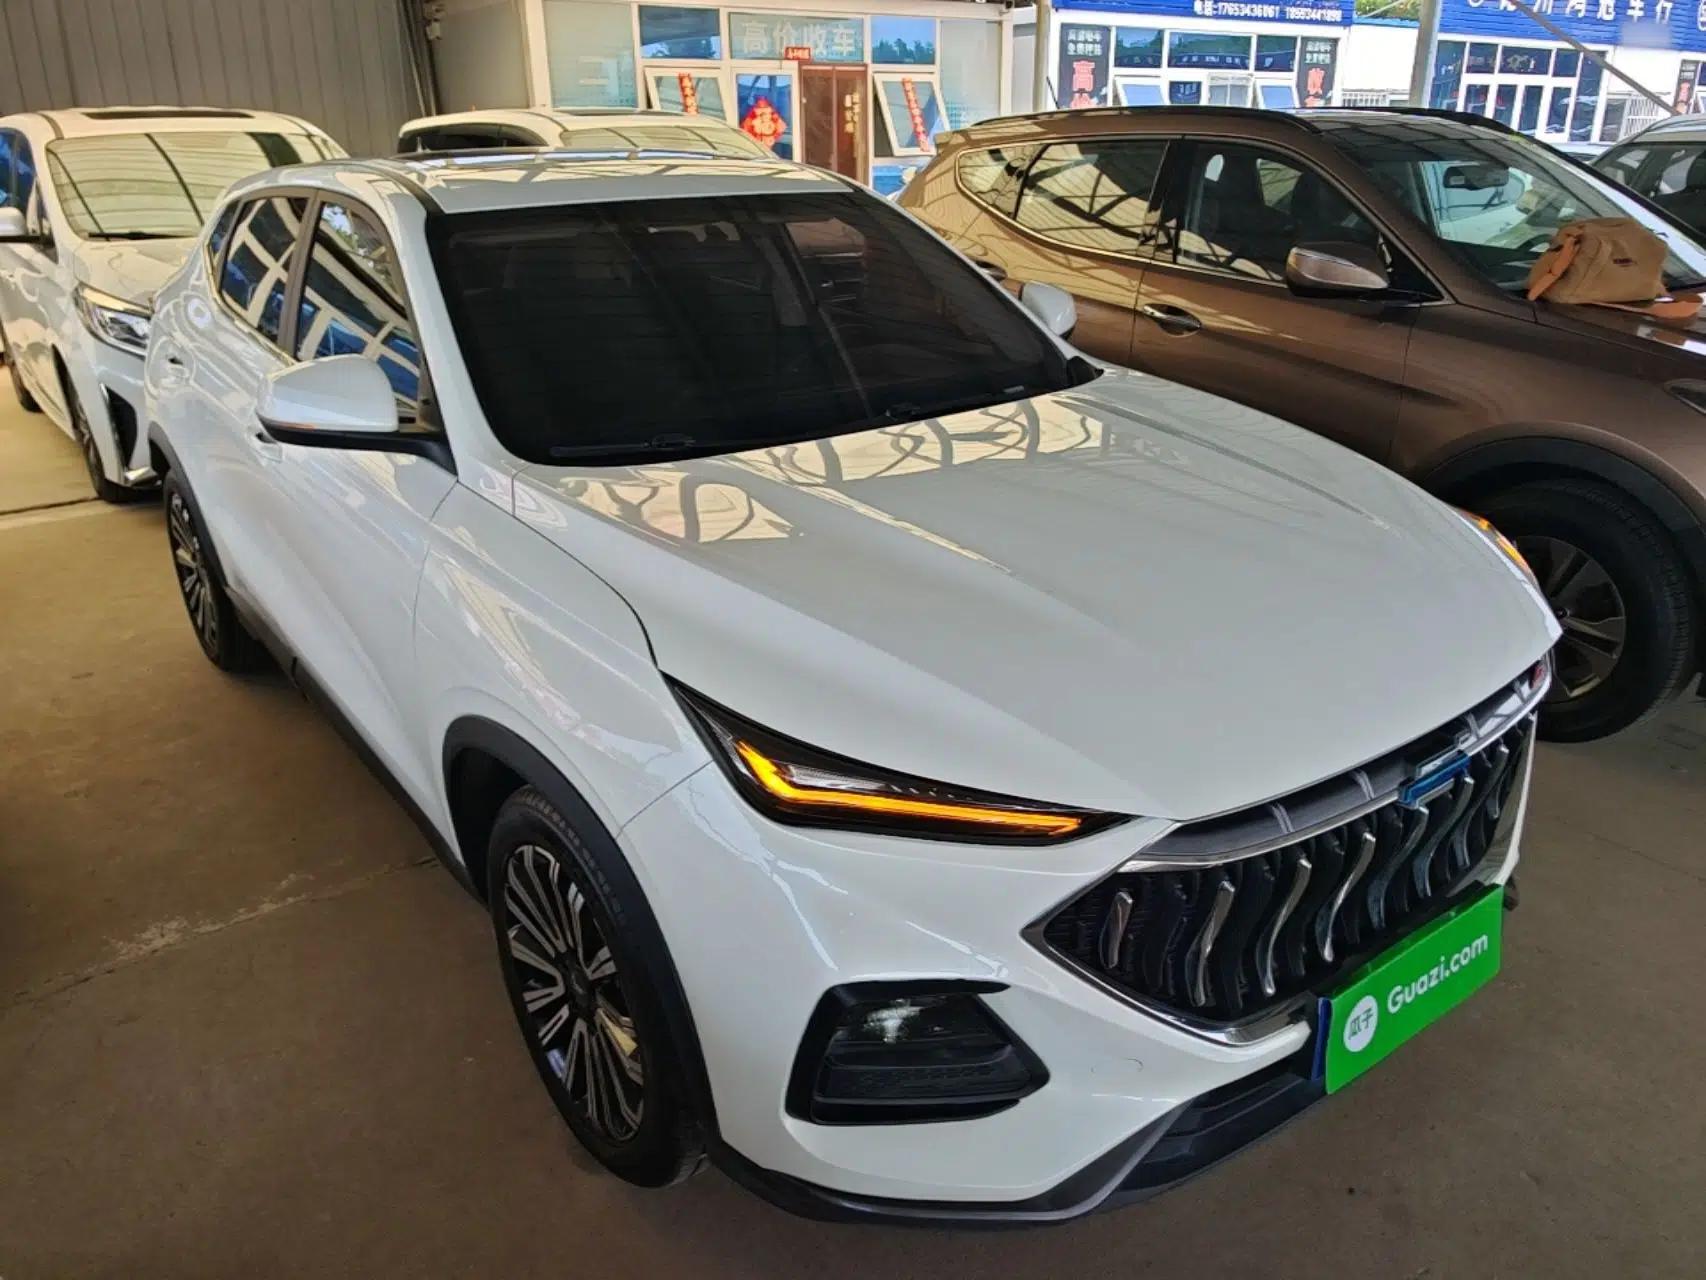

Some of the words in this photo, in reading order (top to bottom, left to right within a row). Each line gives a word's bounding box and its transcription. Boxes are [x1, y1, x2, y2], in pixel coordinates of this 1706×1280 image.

[742, 20, 857, 57] 高价收车
[1387, 934, 1489, 1014] Guazi.com
[1348, 1006, 1374, 1041] 瓜子
